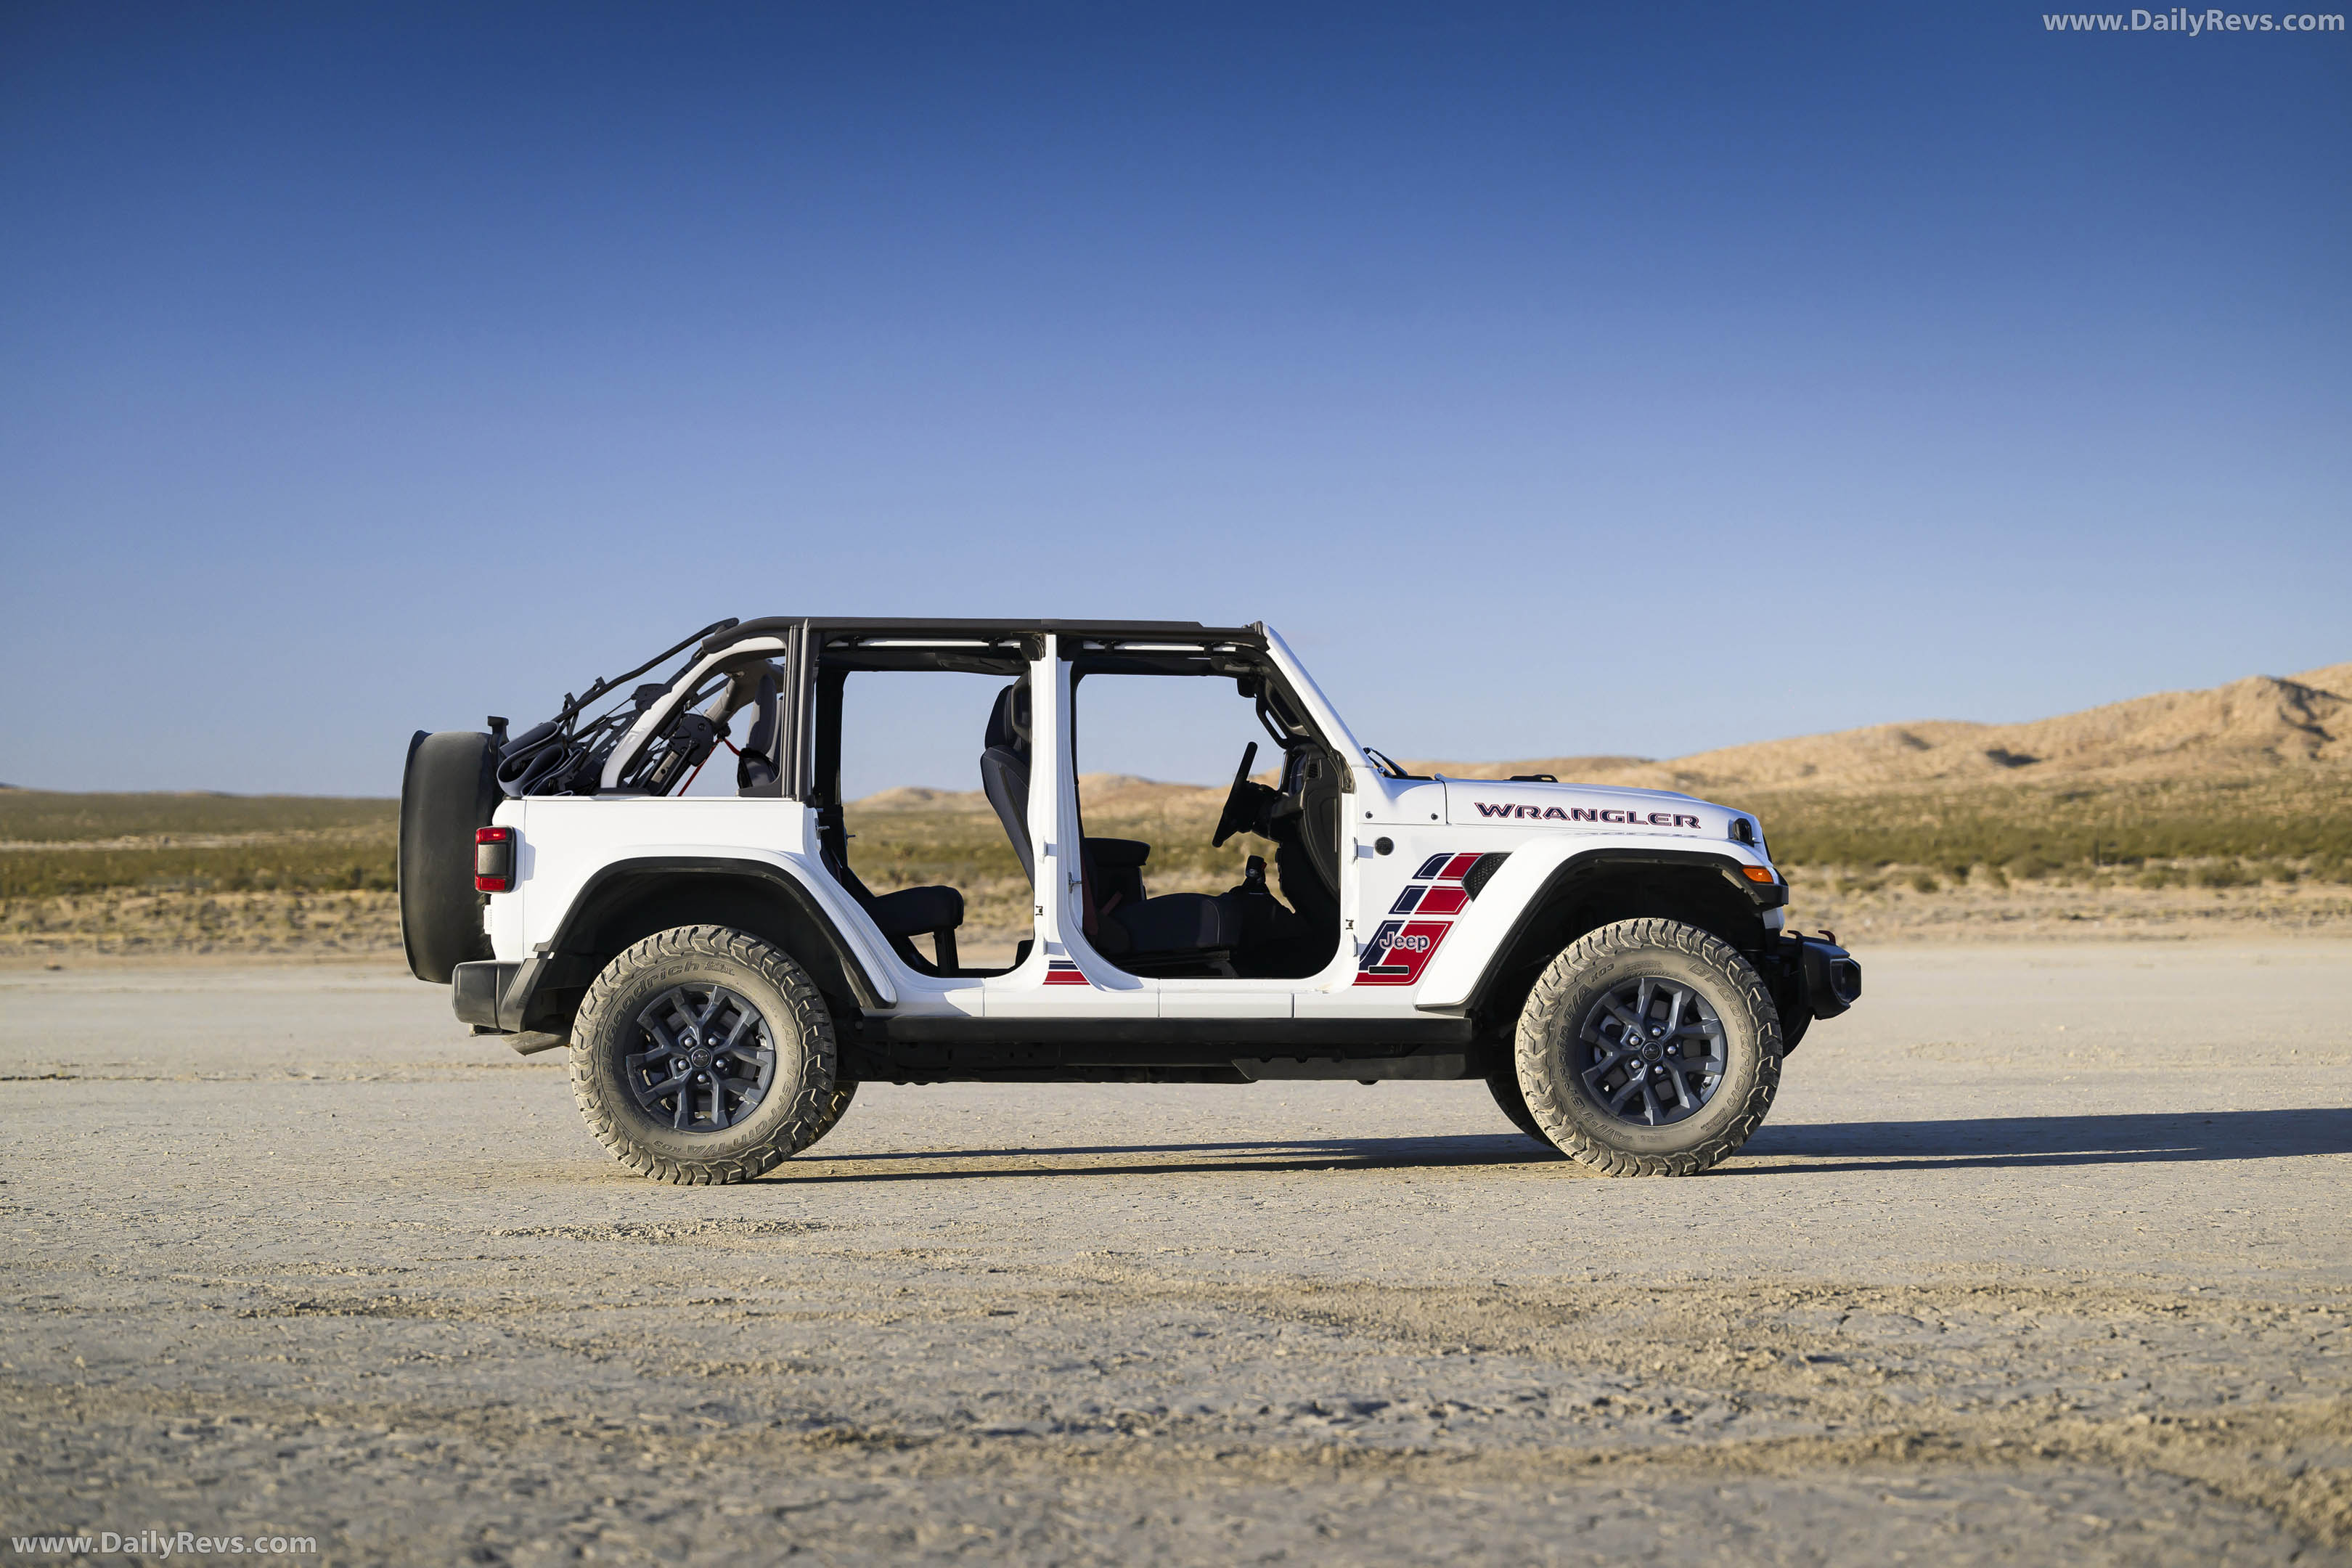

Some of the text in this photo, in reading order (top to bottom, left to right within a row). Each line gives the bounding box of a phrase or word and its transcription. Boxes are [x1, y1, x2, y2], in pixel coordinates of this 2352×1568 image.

[1474, 802, 1702, 829] WRANGLER
[1379, 931, 1430, 952] Jeep
[602, 960, 699, 1077] BFGoodrich
[1688, 963, 1755, 1107] BFGoodrich
